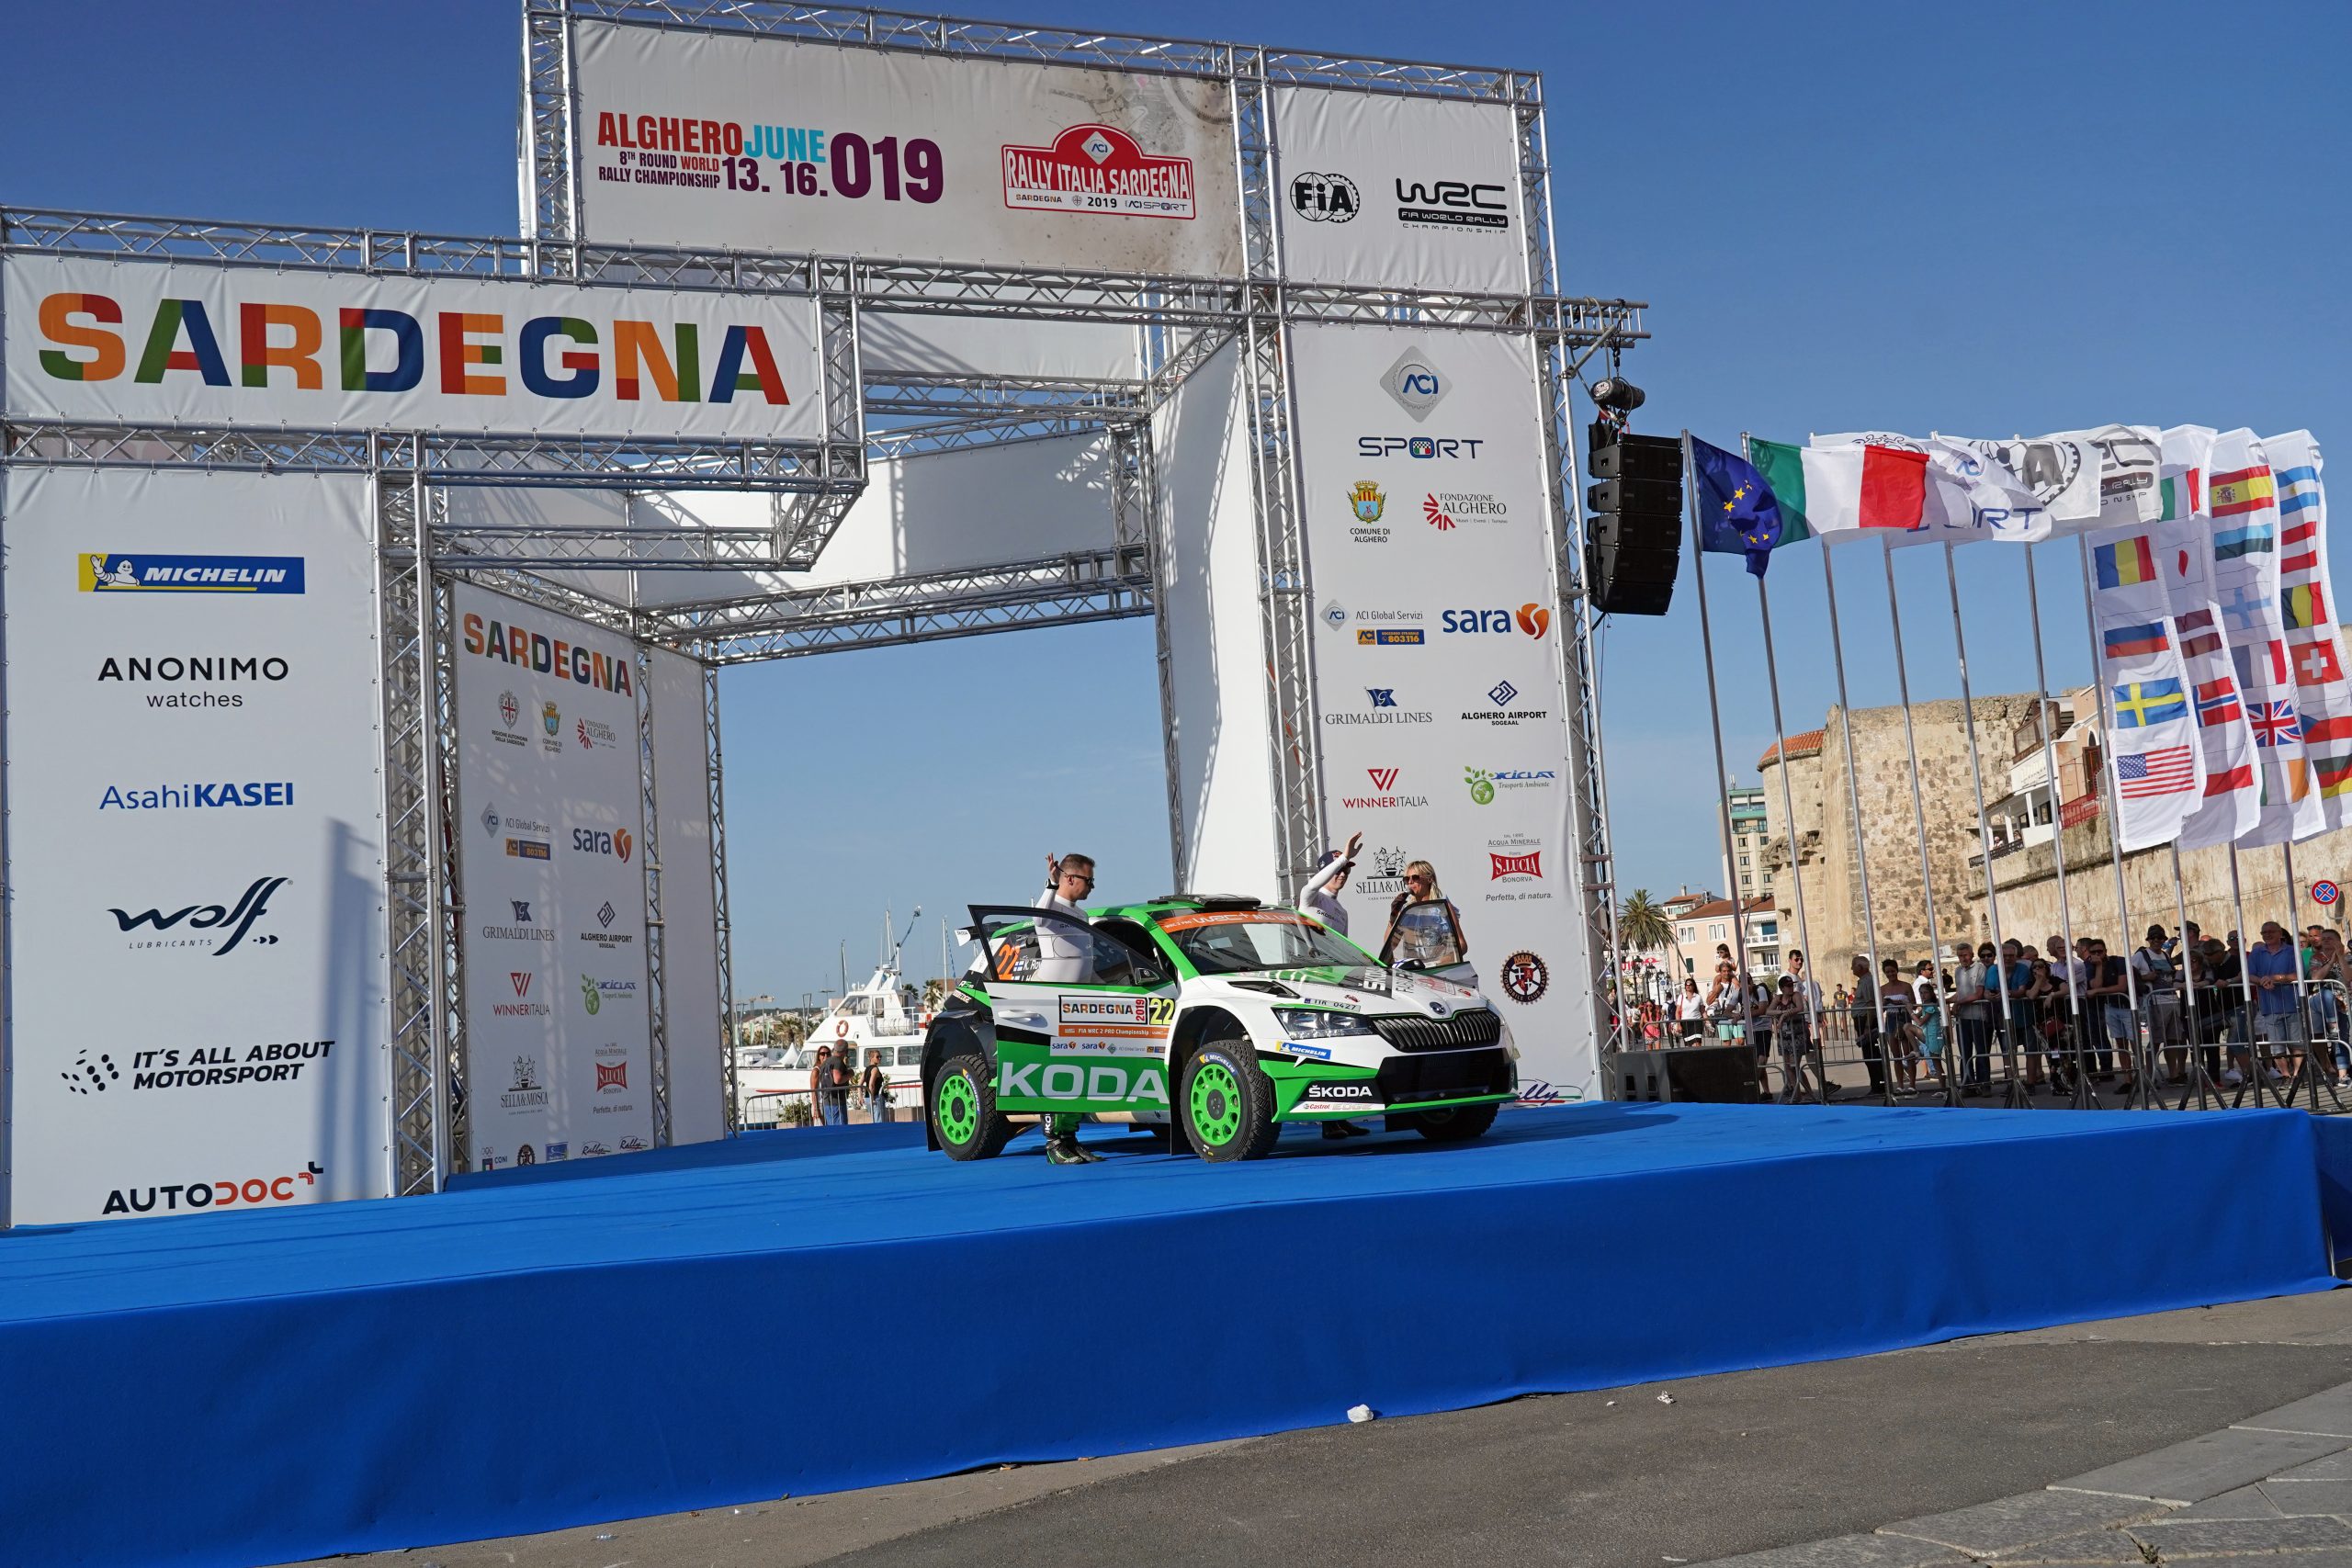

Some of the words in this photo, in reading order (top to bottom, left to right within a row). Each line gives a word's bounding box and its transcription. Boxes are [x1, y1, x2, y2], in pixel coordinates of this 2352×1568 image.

[598, 111, 743, 156] ALGHERO
[743, 124, 826, 163] JUNE
[639, 152, 677, 168] ROUND
[680, 155, 719, 172] WORLD
[830, 131, 944, 204] 019
[598, 166, 631, 183] RALLY
[635, 169, 720, 188] CHAMPIONSHIP
[1006, 150, 1052, 190] RALLY
[1057, 163, 1106, 194] ITALIA
[1109, 163, 1191, 199] SARDEGNA
[1015, 193, 1062, 203] SARDEGNA
[1087, 197, 1117, 208] 2019
[1396, 177, 1508, 210] WRC
[1421, 212, 1463, 222] WORLD
[1465, 215, 1505, 224] RALLY
[1402, 222, 1507, 234] CHAMPIONSHIP
[39, 293, 791, 405] SARDEGNA
[1403, 374, 1439, 395] ACI
[1358, 436, 1484, 459] SPORT
[1440, 493, 1494, 502] FONDAZIONE
[1442, 502, 1507, 514] ALGHERO
[143, 567, 287, 582] MICHELIN
[1356, 611, 1369, 620] ACI
[1371, 611, 1396, 620] Global
[1396, 611, 1423, 620] Servizi
[1442, 609, 1511, 634] sara
[464, 613, 632, 697] SARDEGNA
[97, 657, 288, 681] ANONIMO
[146, 692, 243, 707] watches
[1325, 712, 1394, 725] GRIMALDI
[1396, 712, 1432, 723] LINES
[1461, 711, 1506, 720] ALGHERO
[1508, 711, 1547, 719] AIRPORT
[586, 726, 616, 742] ALGHERO
[1498, 782, 1523, 790] Trasporti
[515, 819, 532, 830] Global
[532, 822, 550, 833] Servizi
[572, 828, 612, 855] sara
[1495, 856, 1538, 875] S.LUCIA
[1486, 893, 1517, 901] Perfetta,
[1519, 892, 1526, 900] di
[482, 926, 530, 941] GRIMALDI
[531, 929, 555, 942] LINES
[581, 932, 607, 942] ALGHERO
[608, 934, 633, 943] AIRPORT
[129, 939, 213, 950] LUBRICANTS
[1063, 1003, 1134, 1014] SARDEGNA
[1135, 999, 1146, 1021] 2019
[1149, 998, 1175, 1025] 22
[133, 1048, 179, 1069] IT'S
[188, 1046, 236, 1065] ALL
[245, 1040, 335, 1062] ABOUT
[1291, 1045, 1327, 1056] MICHELIN
[133, 1063, 305, 1089] MOTORSPORT
[1308, 1084, 1373, 1098] ŠKODA
[494, 1156, 508, 1164] CONI
[102, 1177, 295, 1214] AUTODOC
